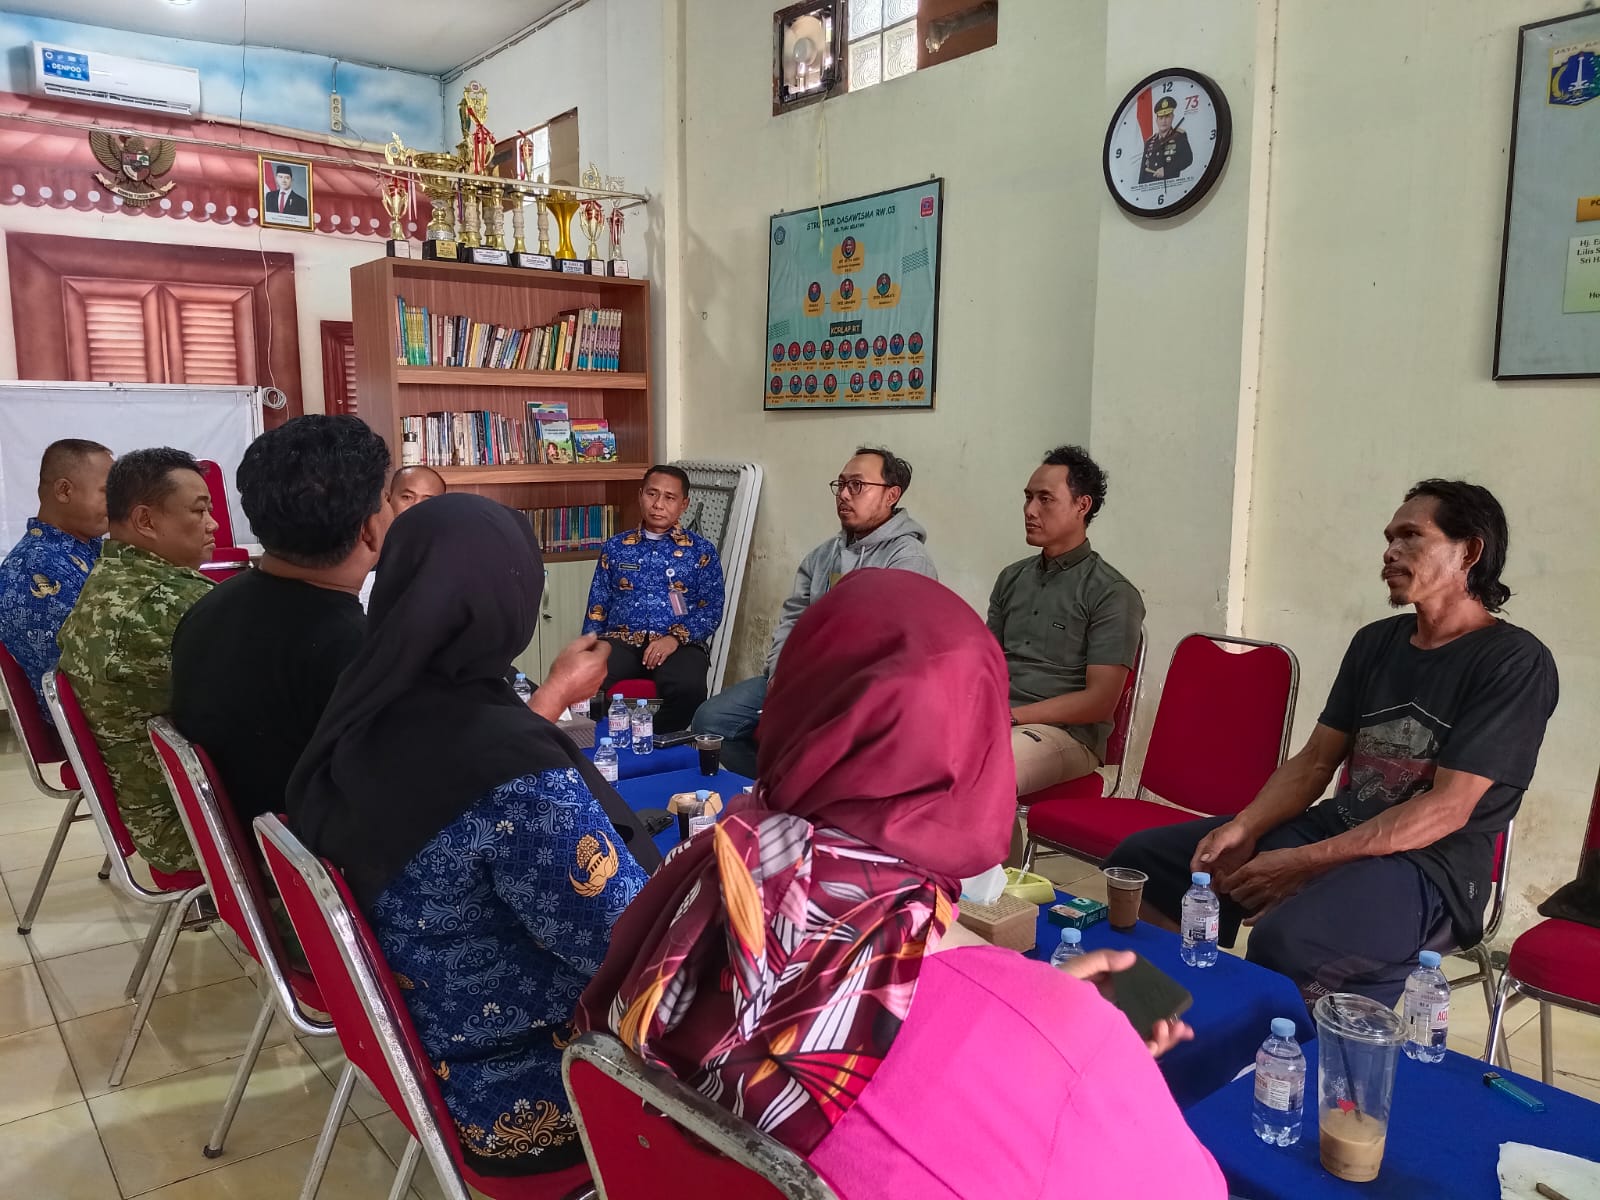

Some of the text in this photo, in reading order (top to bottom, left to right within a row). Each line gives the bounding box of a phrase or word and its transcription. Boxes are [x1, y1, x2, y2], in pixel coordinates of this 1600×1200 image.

[51, 62, 82, 73] DENPOO
[1162, 81, 1173, 93] 12
[1185, 95, 1199, 110] 73
[1210, 129, 1217, 140] 3
[1115, 148, 1122, 158] 9
[1158, 194, 1165, 205] 6
[836, 210, 874, 225] DASAWISMA
[875, 205, 896, 217] RW.03
[1577, 248, 1594, 256] Lilis
